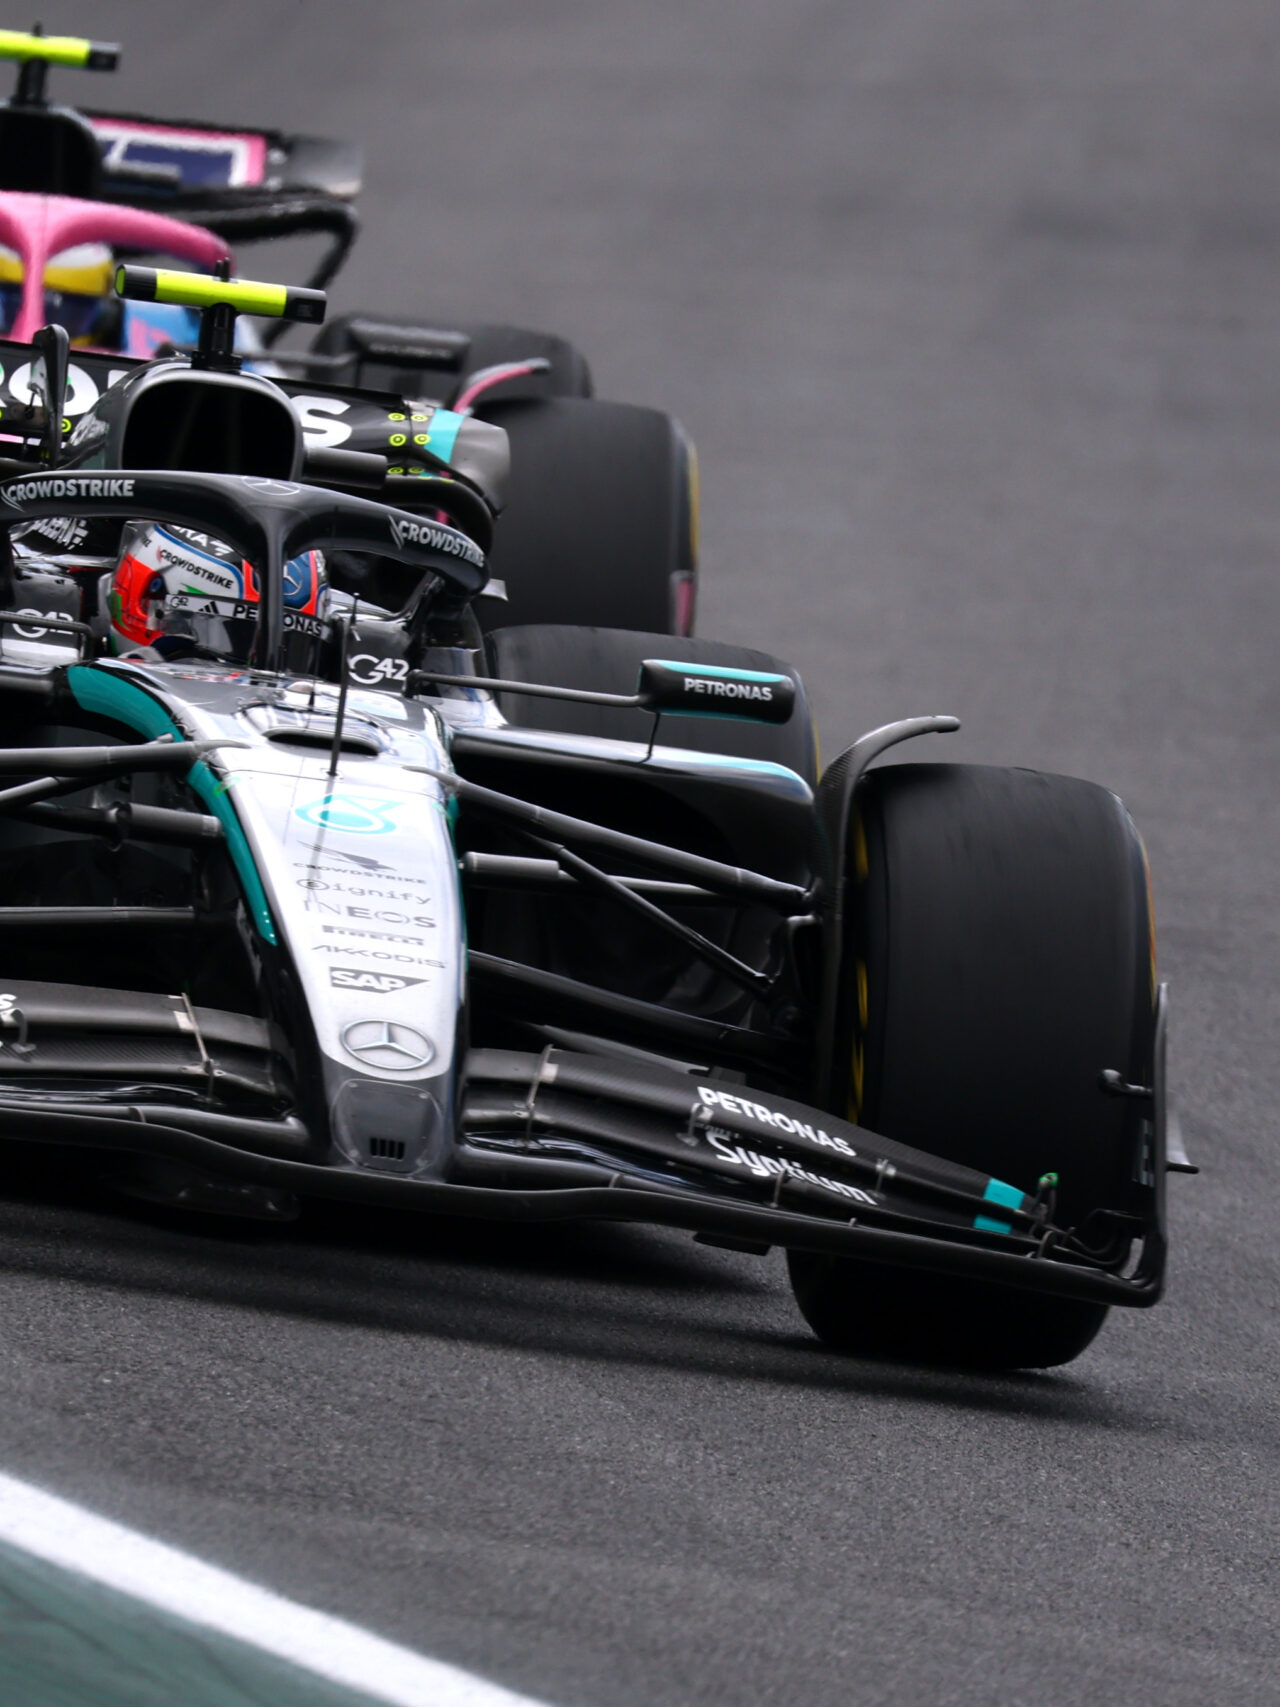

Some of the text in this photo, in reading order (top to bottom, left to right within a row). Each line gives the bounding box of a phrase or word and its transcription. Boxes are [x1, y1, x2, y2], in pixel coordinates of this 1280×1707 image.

[7, 479, 135, 501] CROWDSTRIKE
[398, 520, 485, 568] CROWDSTRIKE
[159, 549, 235, 589] CROWDSTRIKE
[233, 604, 322, 636] PEONAS
[347, 653, 410, 685] G42
[684, 678, 773, 701] PETRONAS
[293, 862, 427, 885] CROWDSTRIKE
[303, 899, 437, 928] INEOS
[322, 925, 424, 946] PIRELLI
[331, 969, 407, 991] SAP
[697, 1086, 857, 1157] PETRONAS
[706, 1131, 878, 1206] Syntium
